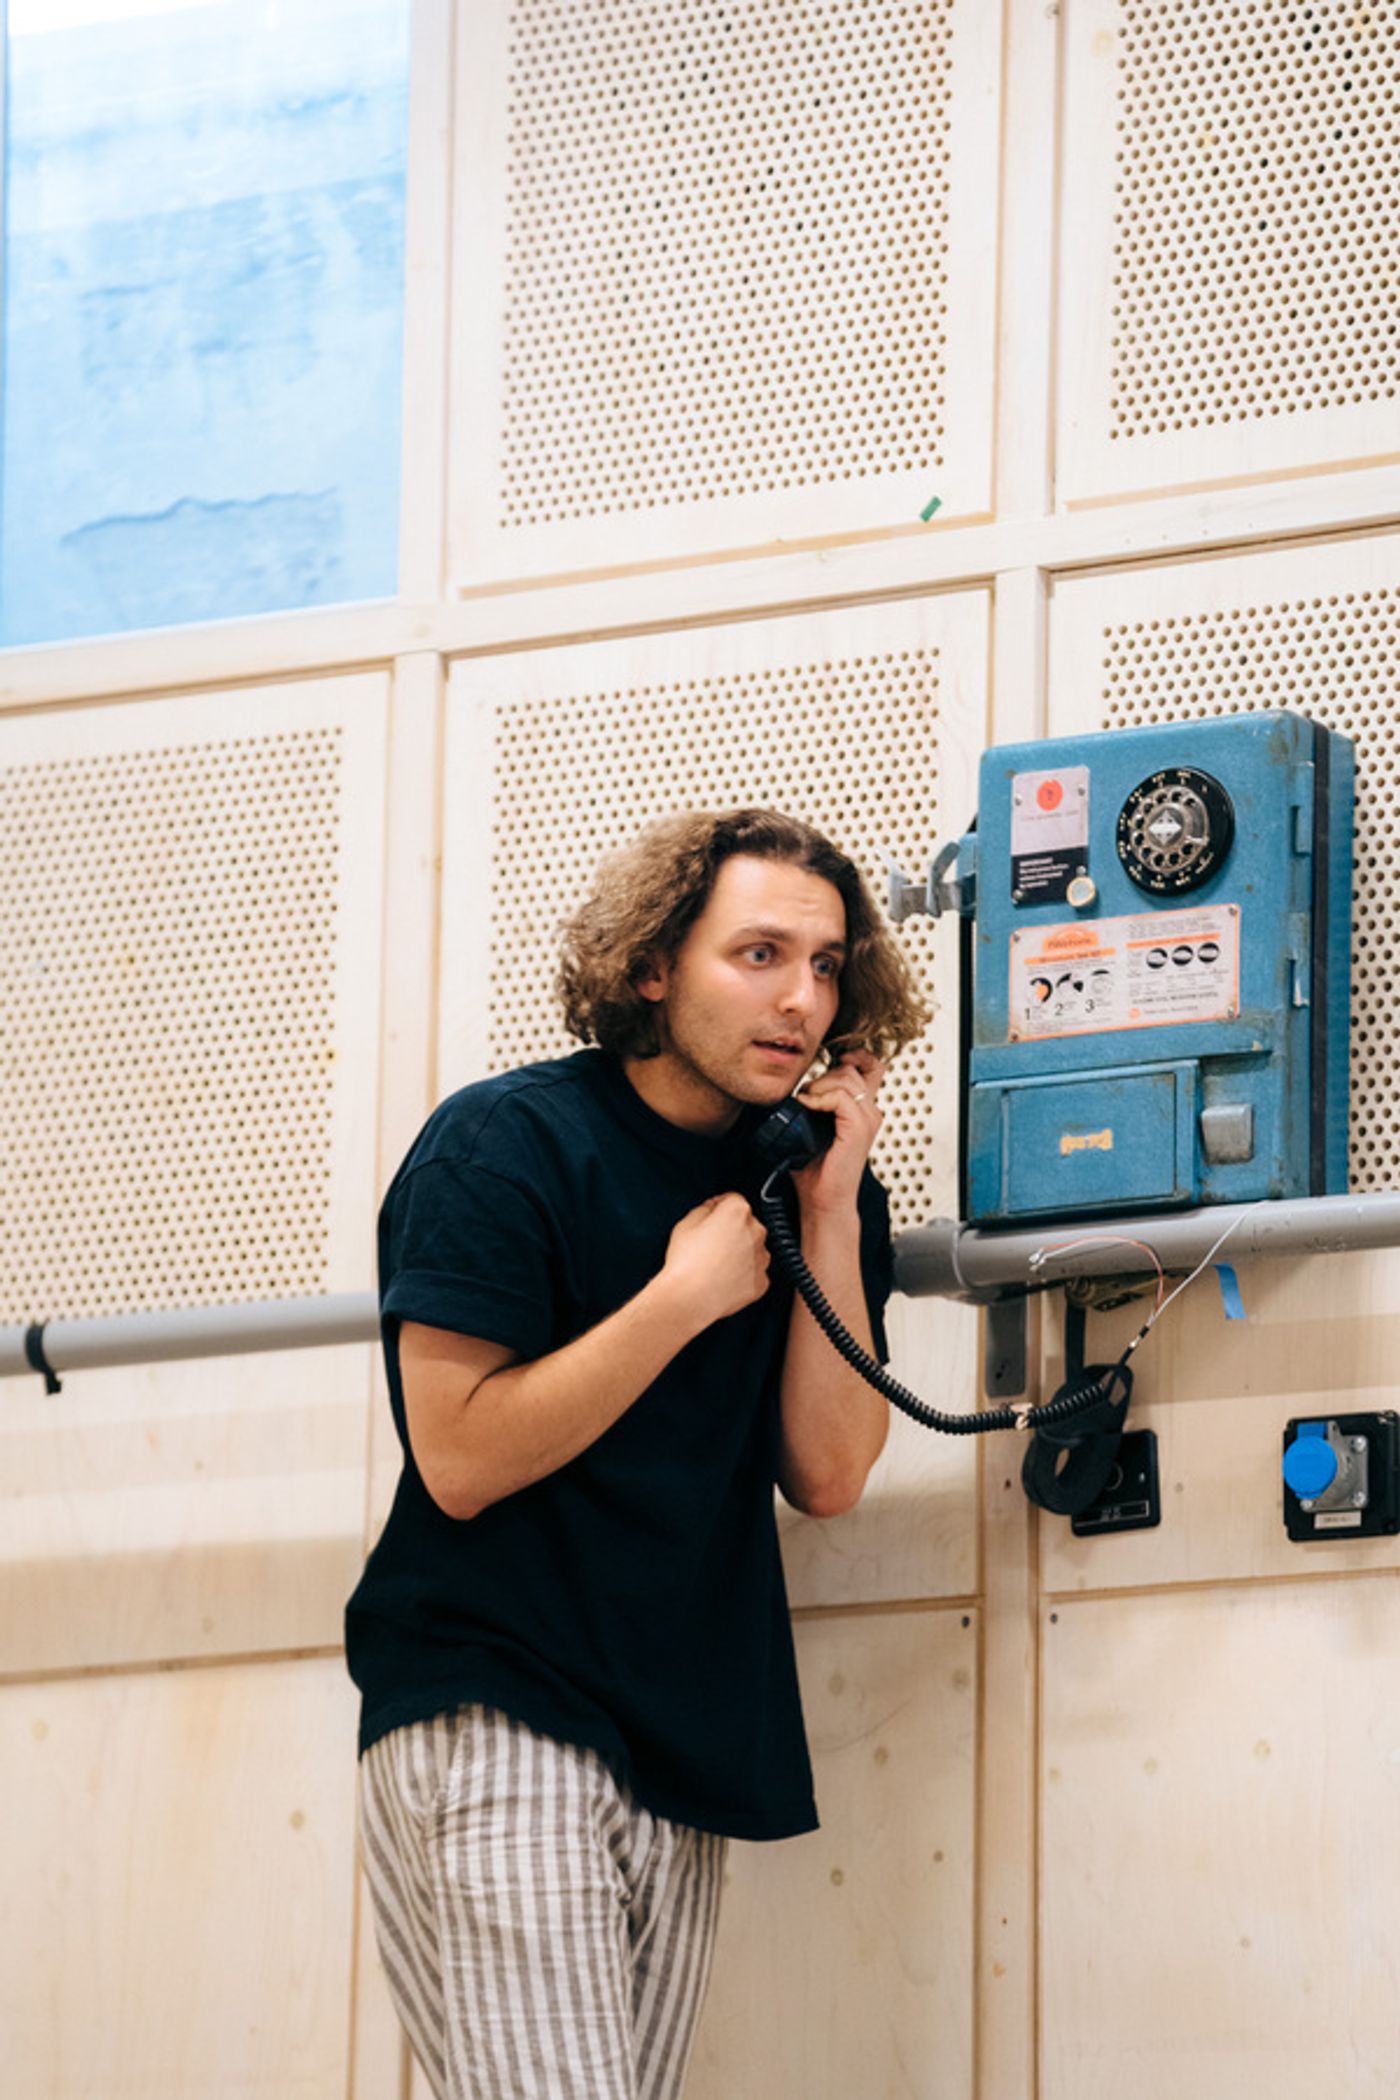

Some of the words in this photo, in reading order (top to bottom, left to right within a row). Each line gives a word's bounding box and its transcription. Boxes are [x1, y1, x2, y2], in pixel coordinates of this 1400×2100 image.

[1054, 1002, 1064, 1016] 2
[1085, 999, 1095, 1014] 3
[1025, 1008, 1030, 1020] 1
